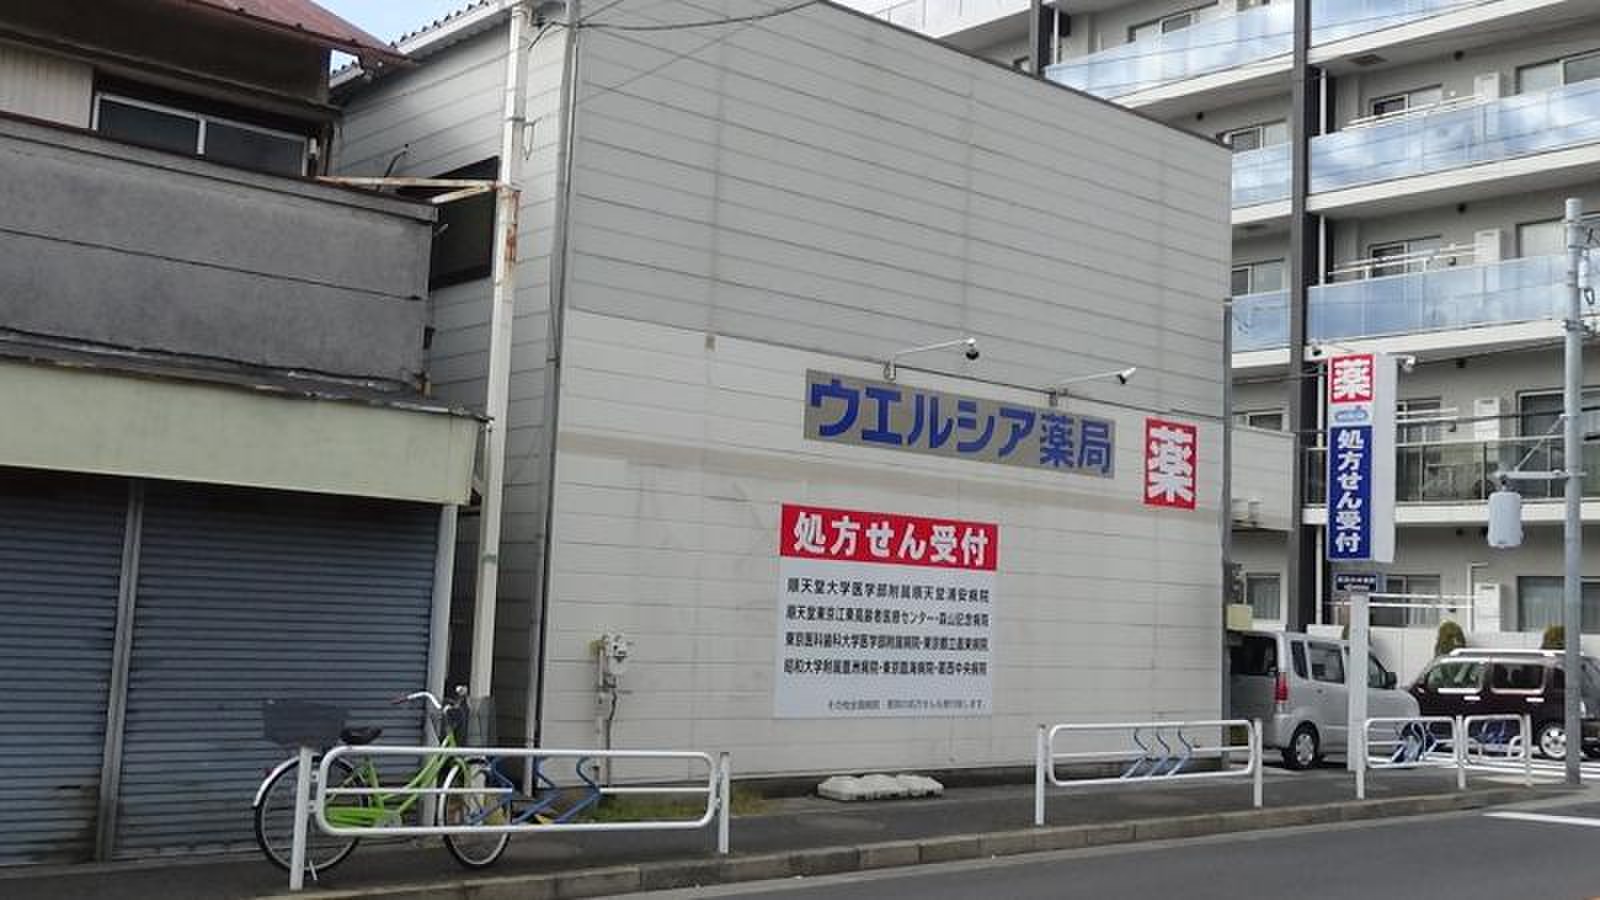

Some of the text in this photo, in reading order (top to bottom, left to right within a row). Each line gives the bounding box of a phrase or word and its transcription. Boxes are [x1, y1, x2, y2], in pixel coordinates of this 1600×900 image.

[1333, 359, 1371, 399] 薬
[811, 379, 1111, 474] ウエルシア薬局
[1146, 426, 1193, 502] 薬
[1335, 429, 1364, 553] 処方せん受付
[793, 511, 989, 566] 処方せん受付
